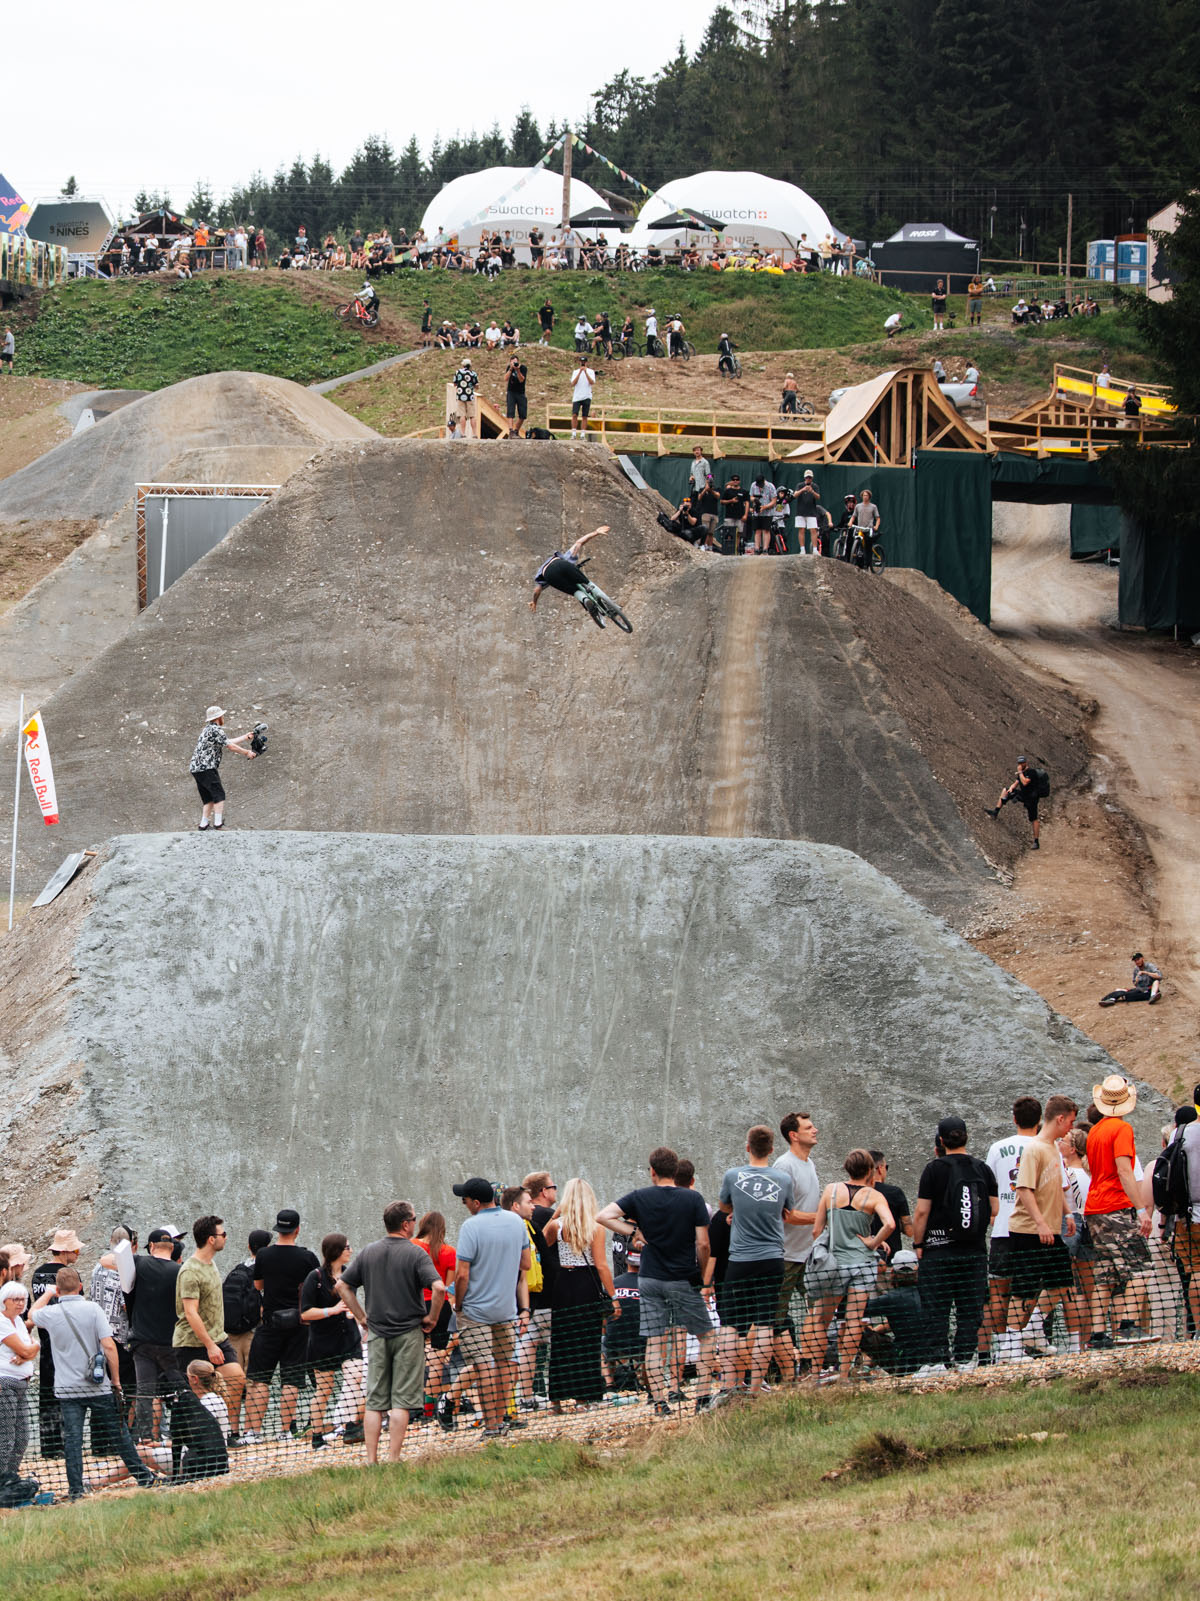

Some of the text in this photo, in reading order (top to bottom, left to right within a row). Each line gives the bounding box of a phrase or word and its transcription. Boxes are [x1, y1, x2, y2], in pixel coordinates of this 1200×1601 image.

[0, 193, 23, 207] Red
[488, 205, 544, 216] swatch
[702, 208, 757, 219] swatch
[56, 226, 89, 237] NINES
[908, 230, 939, 238] ROSE
[29, 758, 53, 810] Red Bull
[1000, 1145, 1016, 1158] NO
[741, 1181, 775, 1192] FOX
[960, 1185, 971, 1229] adidas
[33, 1283, 48, 1294] BYN
